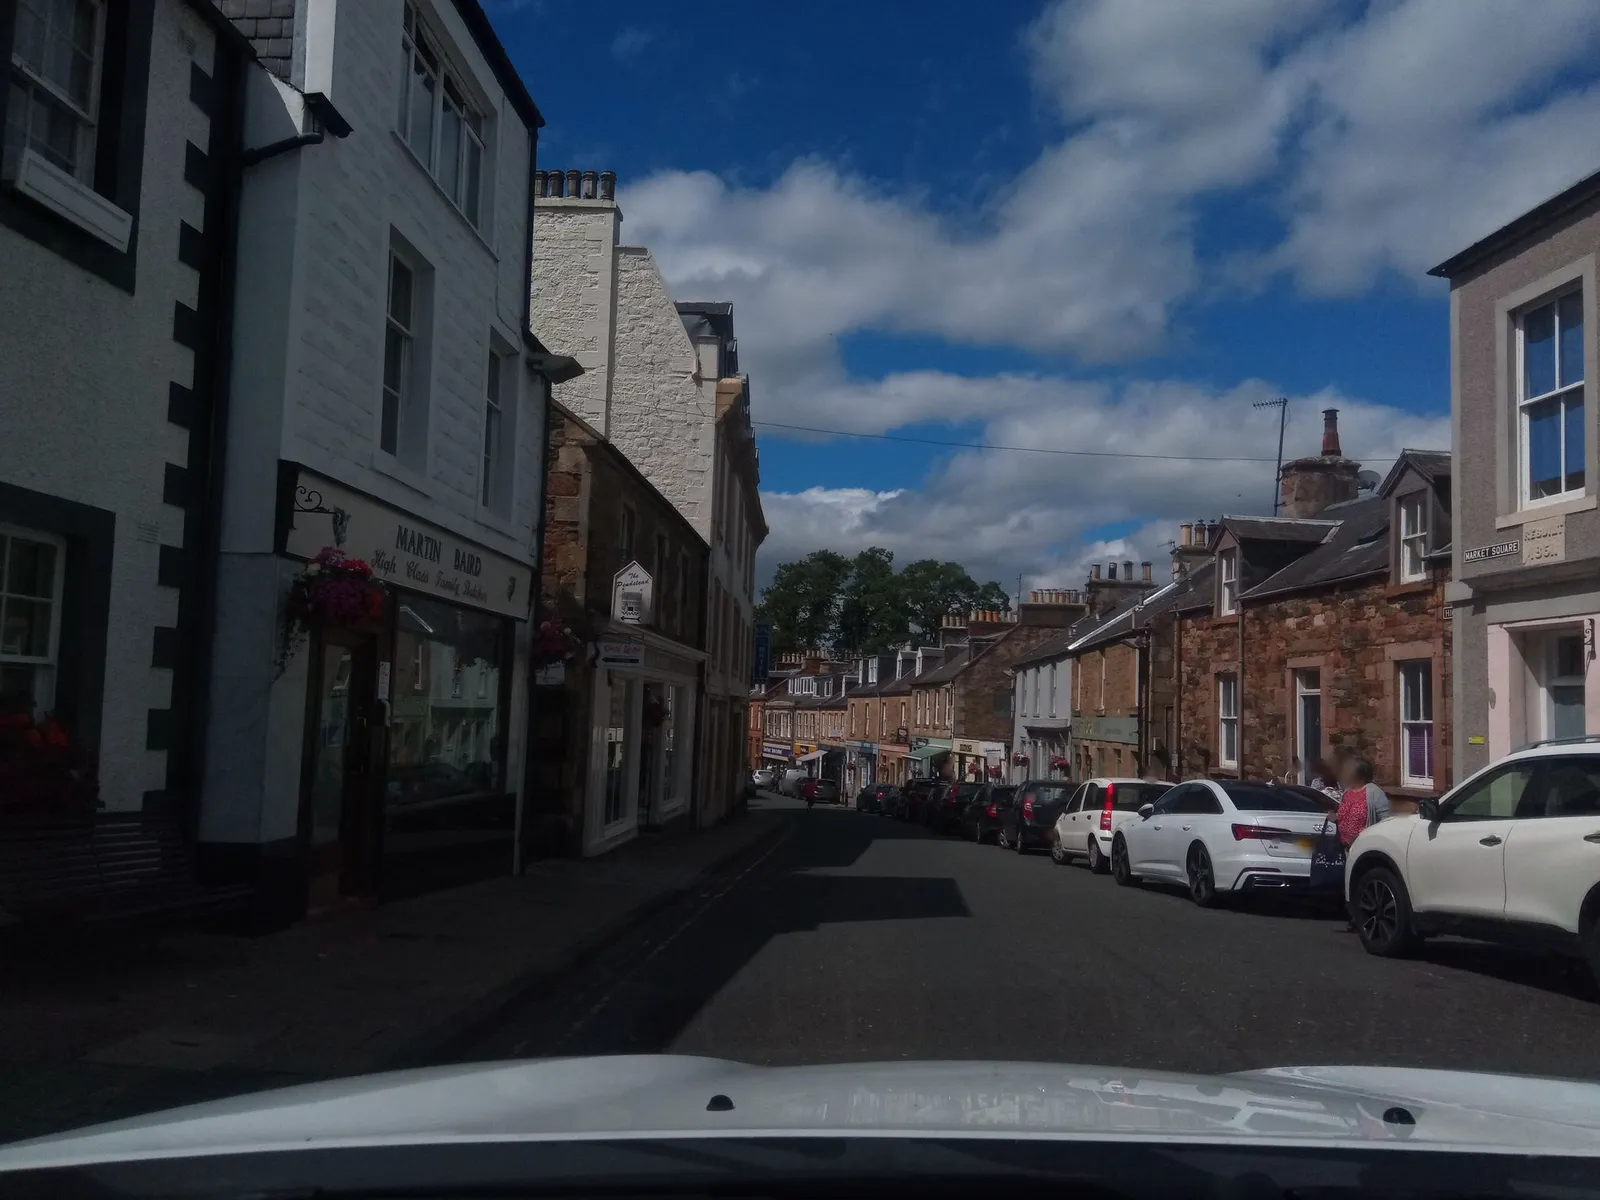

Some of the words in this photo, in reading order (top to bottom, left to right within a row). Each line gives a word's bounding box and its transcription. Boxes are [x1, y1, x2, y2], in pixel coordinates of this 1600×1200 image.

[370, 548, 397, 577] High
[406, 560, 429, 584] Class
[434, 569, 461, 597] Family
[395, 525, 443, 564] MARTIN
[453, 548, 482, 577] BAIRD
[1465, 547, 1490, 561] MARKET
[1491, 542, 1518, 556] SQUARE
